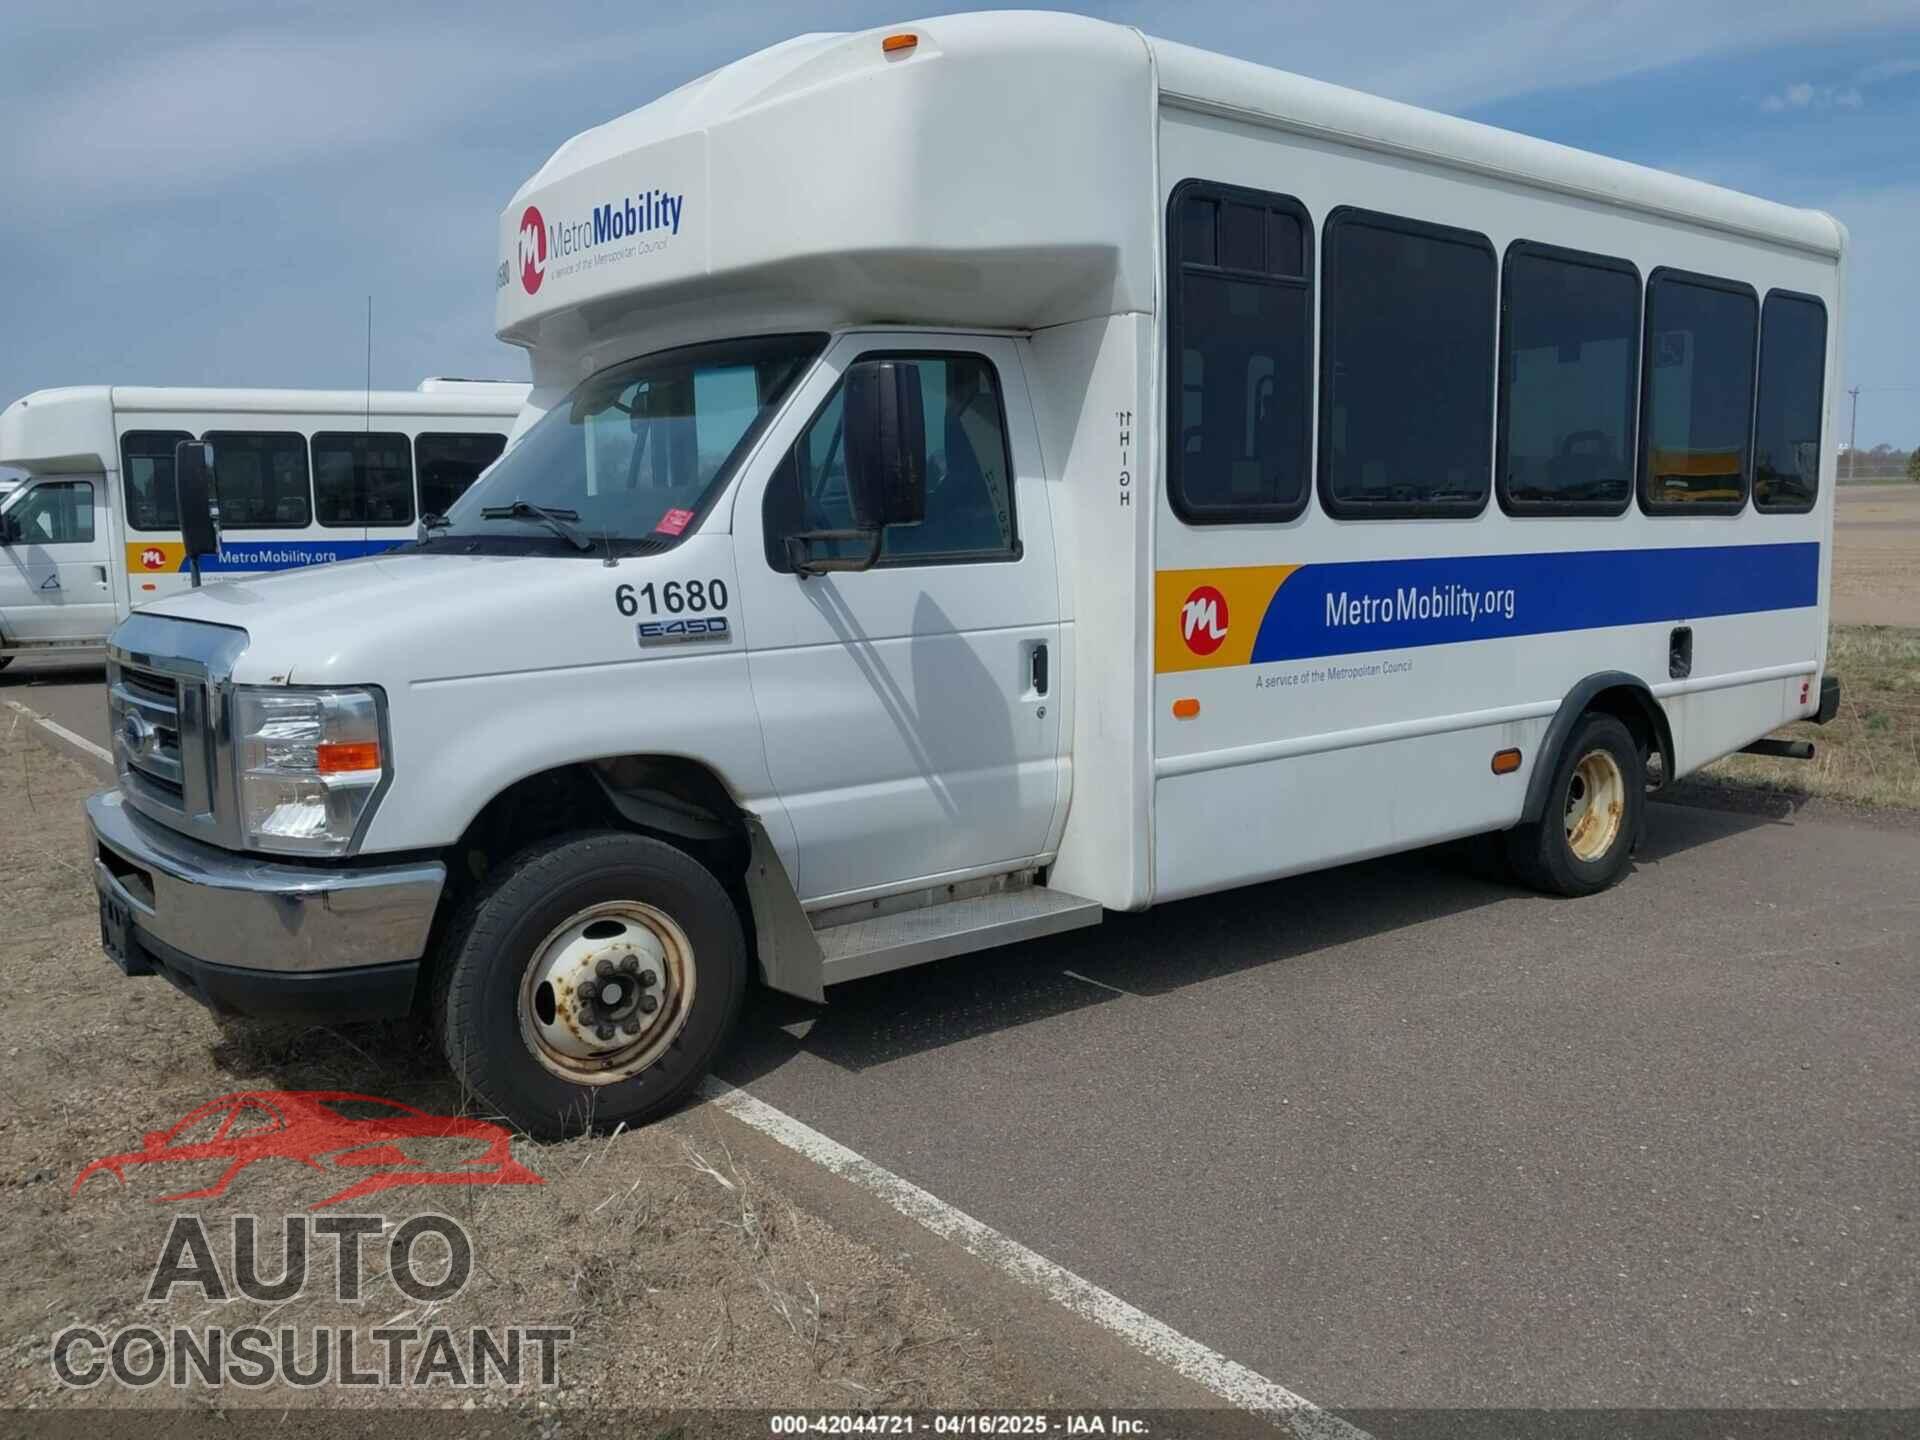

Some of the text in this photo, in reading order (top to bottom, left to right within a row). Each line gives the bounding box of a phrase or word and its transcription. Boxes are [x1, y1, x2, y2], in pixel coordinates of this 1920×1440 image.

[550, 189, 683, 260] MetroMobility
[218, 549, 337, 566] MetroMobility.org
[615, 578, 729, 617] 61680
[1325, 584, 1515, 627] MetroMobility.org
[1255, 659, 1413, 689] A service of the Metropolitan Council
